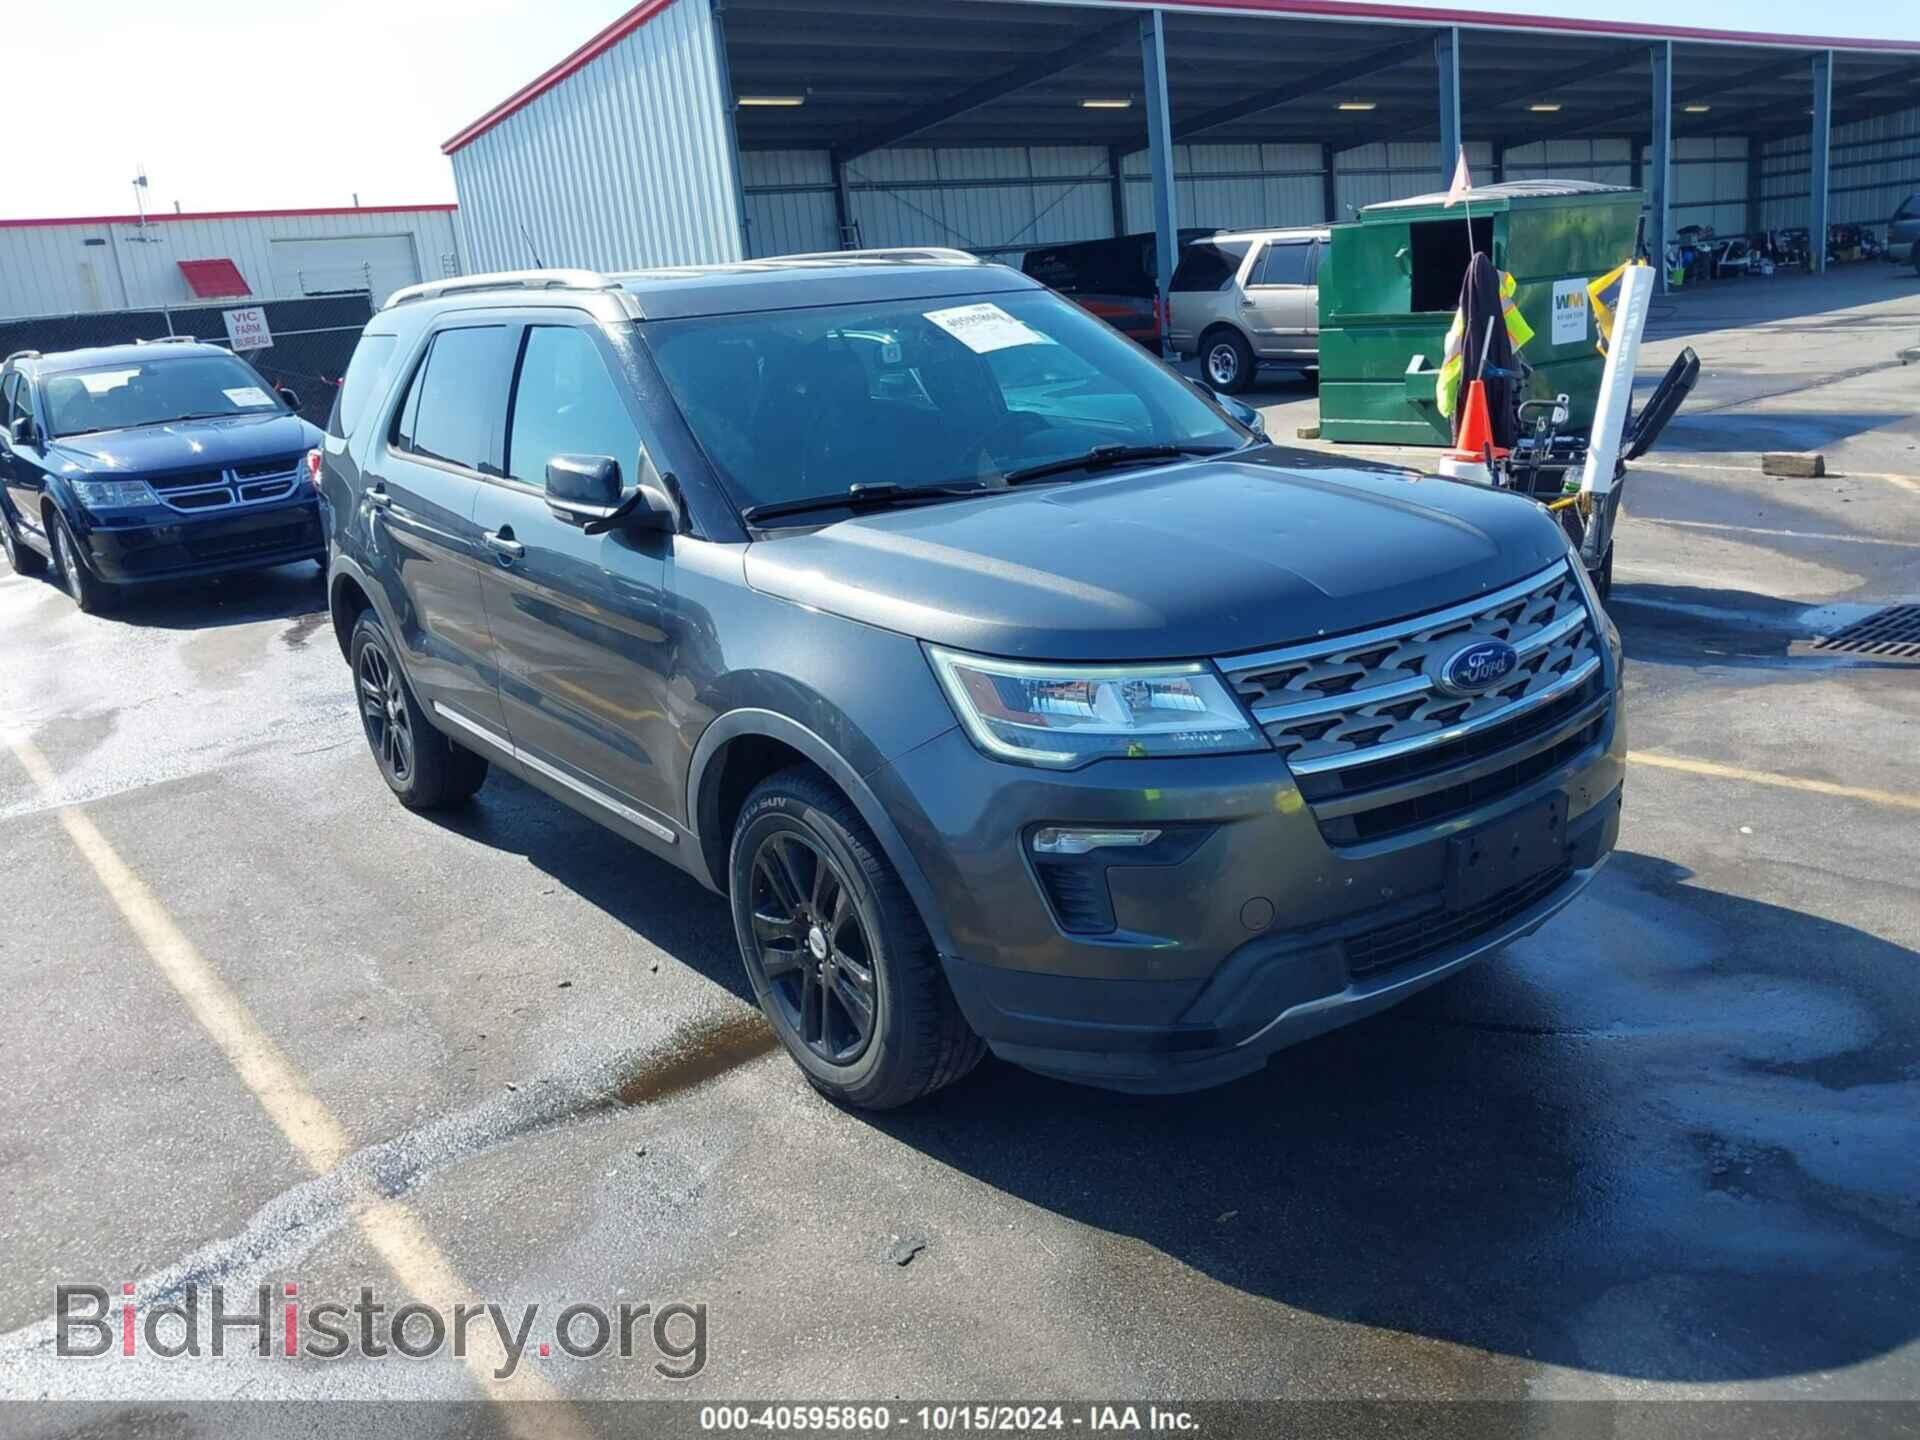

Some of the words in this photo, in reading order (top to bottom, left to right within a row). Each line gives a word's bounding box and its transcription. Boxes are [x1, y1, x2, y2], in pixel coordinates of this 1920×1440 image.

[1555, 292, 1585, 310] WM
[231, 311, 257, 322] VIC
[235, 323, 260, 335] FARM
[235, 335, 270, 348] BUREAU
[1461, 649, 1506, 682] Ford
